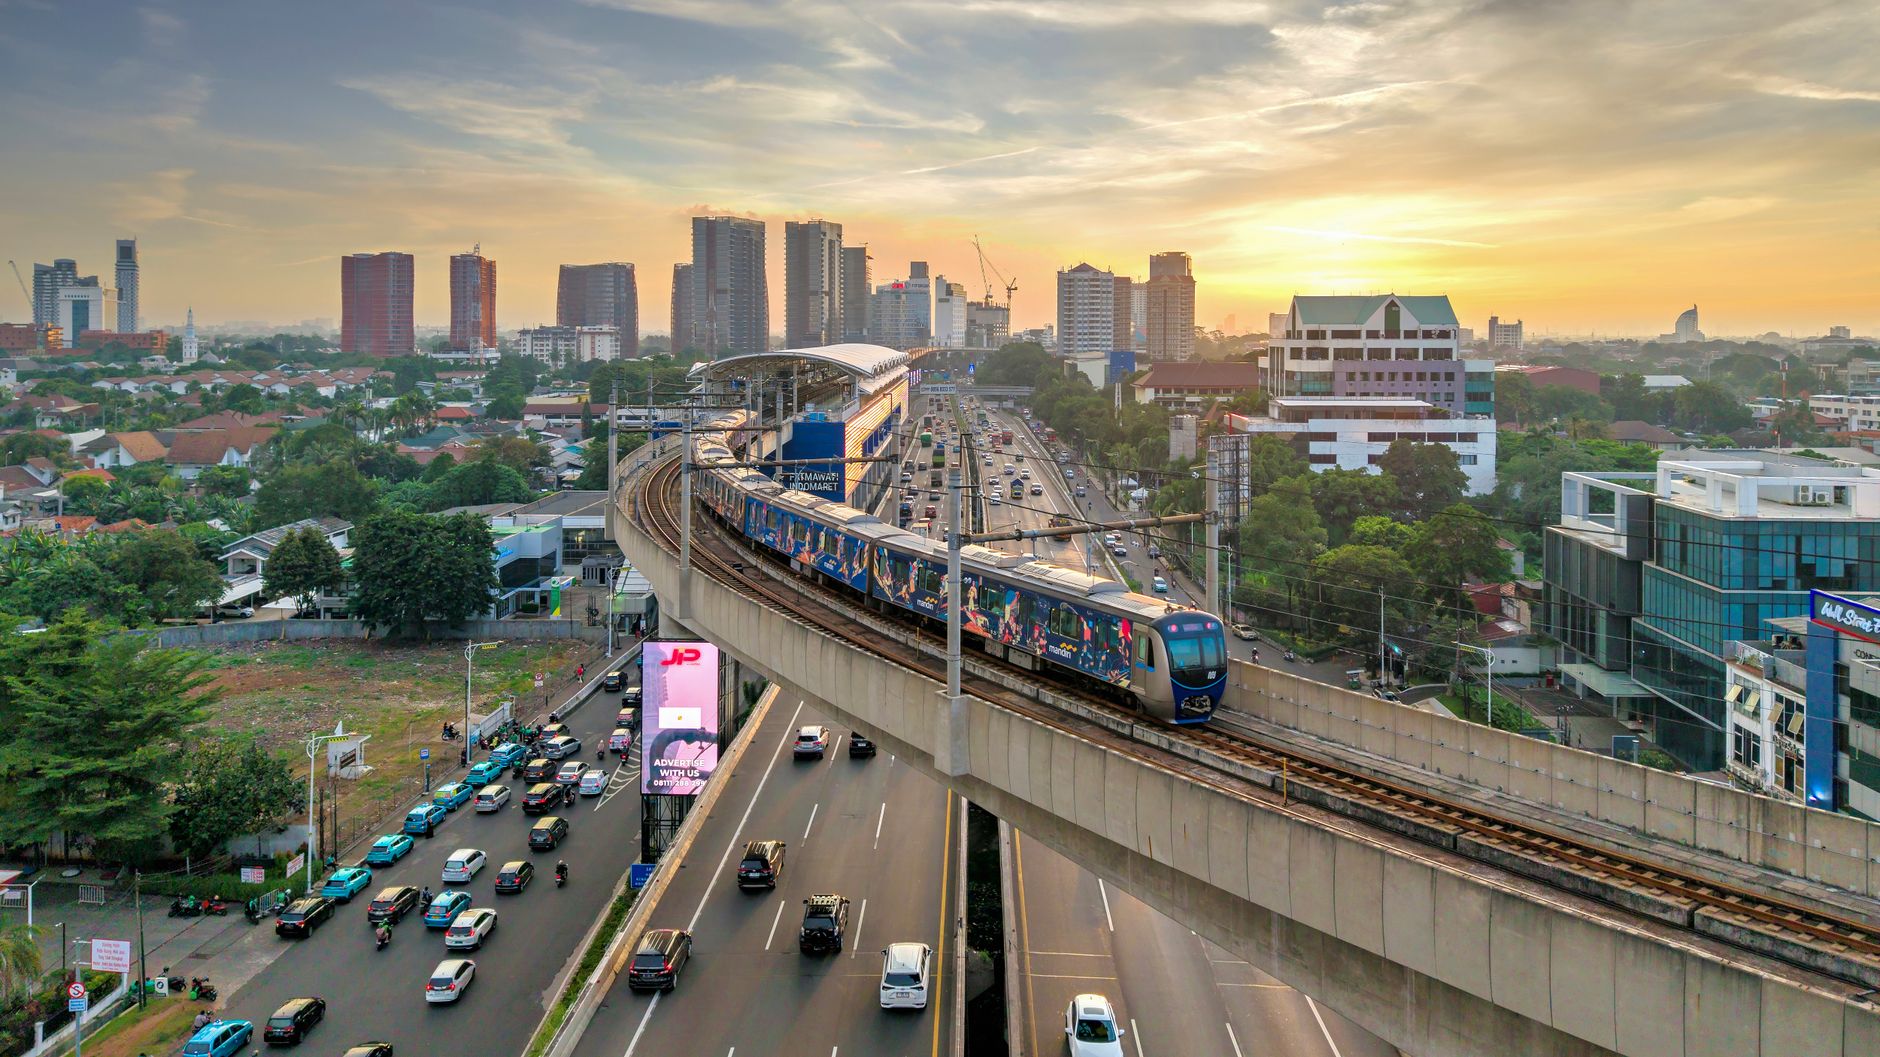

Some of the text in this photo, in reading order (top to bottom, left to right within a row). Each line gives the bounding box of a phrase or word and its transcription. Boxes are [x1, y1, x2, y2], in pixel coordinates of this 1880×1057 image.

[790, 482, 839, 491] INDOMARET
[653, 758, 705, 767] ADVERTISE
[659, 769, 700, 777] WITH US
